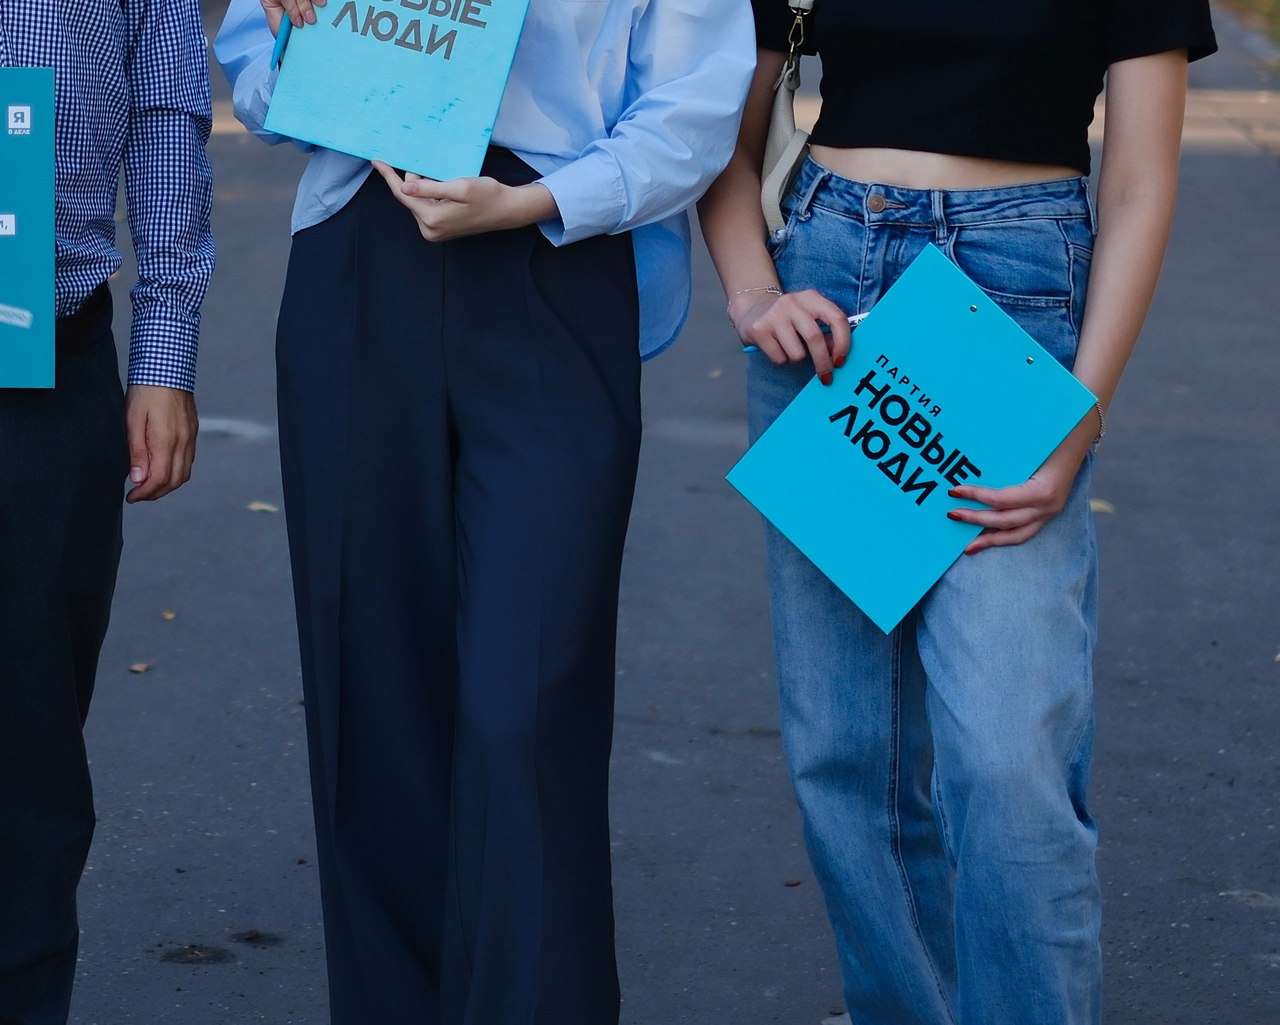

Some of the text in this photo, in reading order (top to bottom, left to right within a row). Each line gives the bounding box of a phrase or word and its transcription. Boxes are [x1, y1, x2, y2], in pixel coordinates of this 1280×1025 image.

[331, 1, 457, 60] ЛЮДИ
[13, 111, 25, 124] Я
[875, 354, 942, 417] ПАРТИЯ
[829, 404, 939, 506] ЛЮДИ
[853, 369, 982, 487] НОВЫЕ
